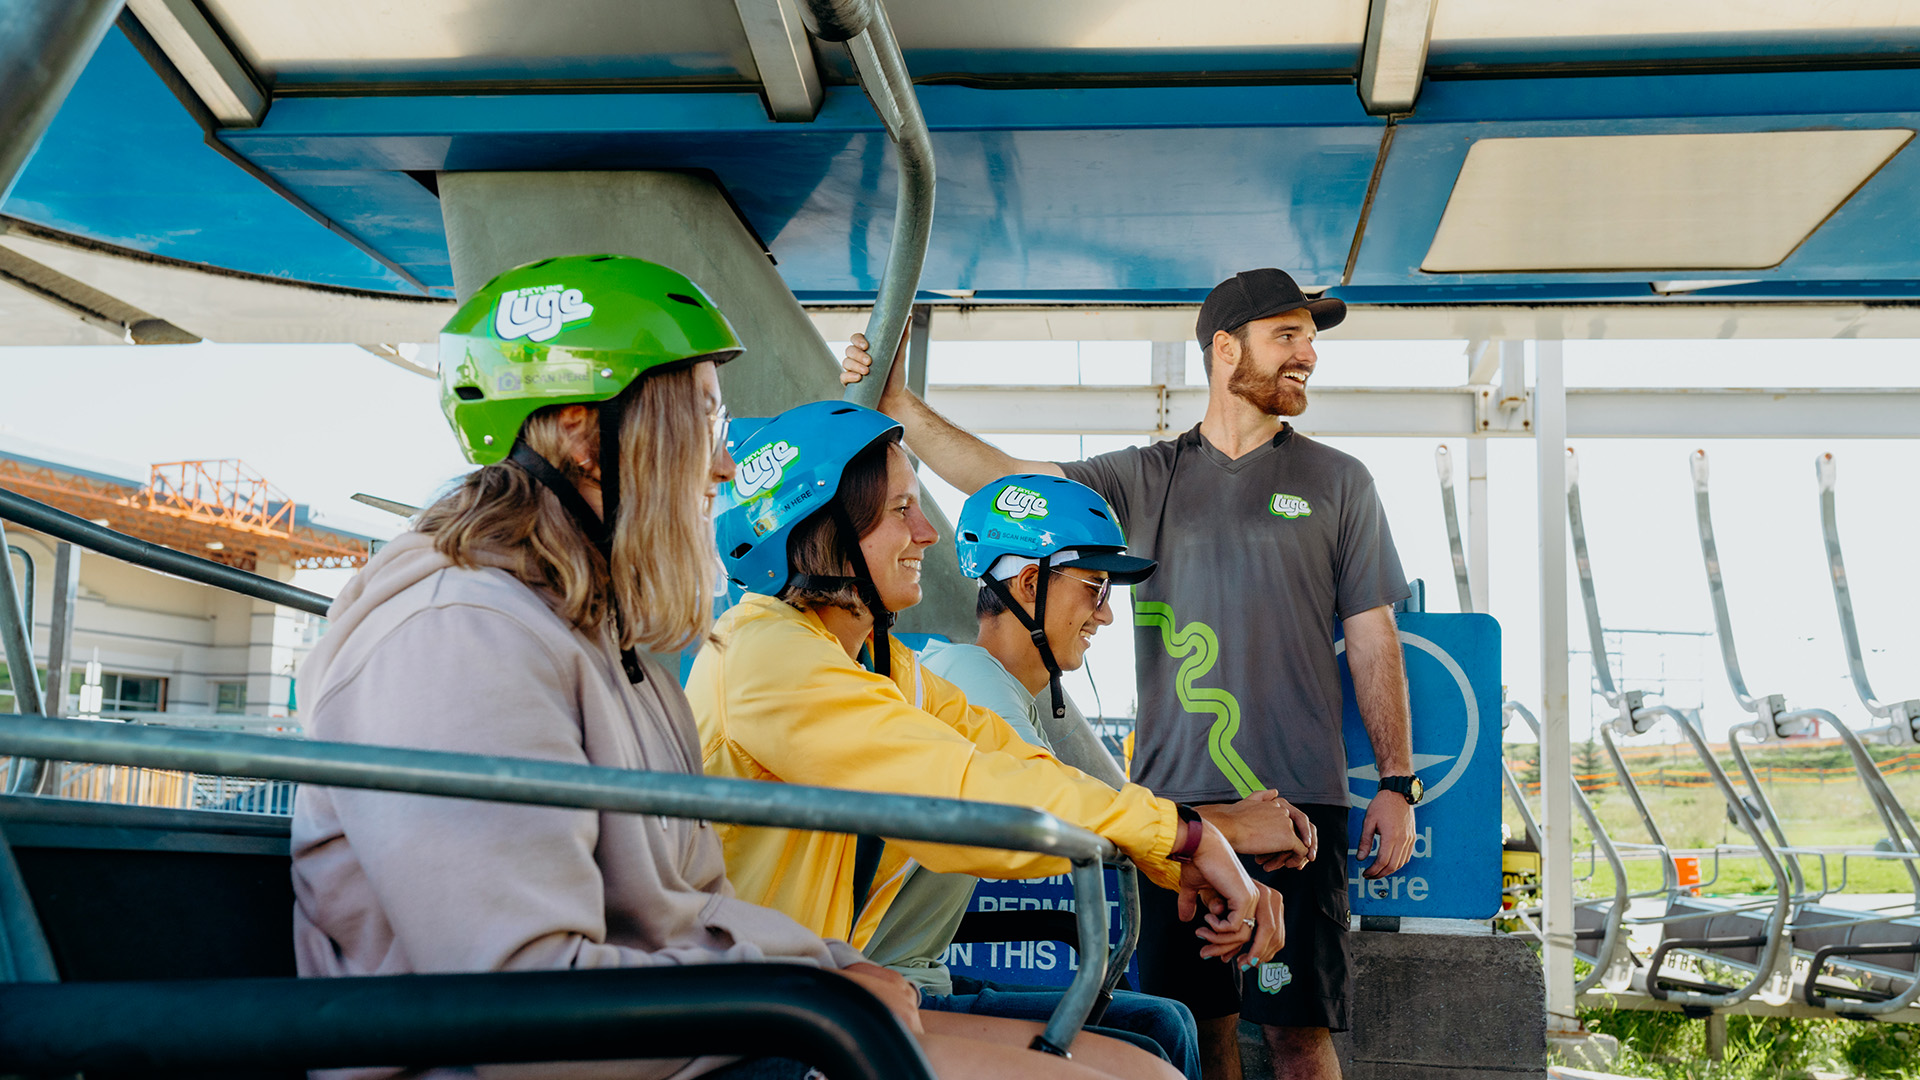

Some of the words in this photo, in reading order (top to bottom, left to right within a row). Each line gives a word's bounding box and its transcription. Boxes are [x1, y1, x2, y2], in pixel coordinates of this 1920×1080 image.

[520, 284, 564, 297] SKYLINE
[495, 289, 594, 342] Luge
[525, 374, 555, 385] SCAN
[559, 371, 590, 382] HERE
[735, 440, 799, 497] Luge
[770, 503, 791, 520] SCAN
[792, 489, 813, 507] HERE
[996, 485, 1049, 519] Luge
[1273, 494, 1311, 517] Luge
[1002, 532, 1019, 541] SCAN
[1020, 535, 1037, 544] HERE
[984, 940, 1057, 970] THIS
[1261, 963, 1292, 990] Luge
